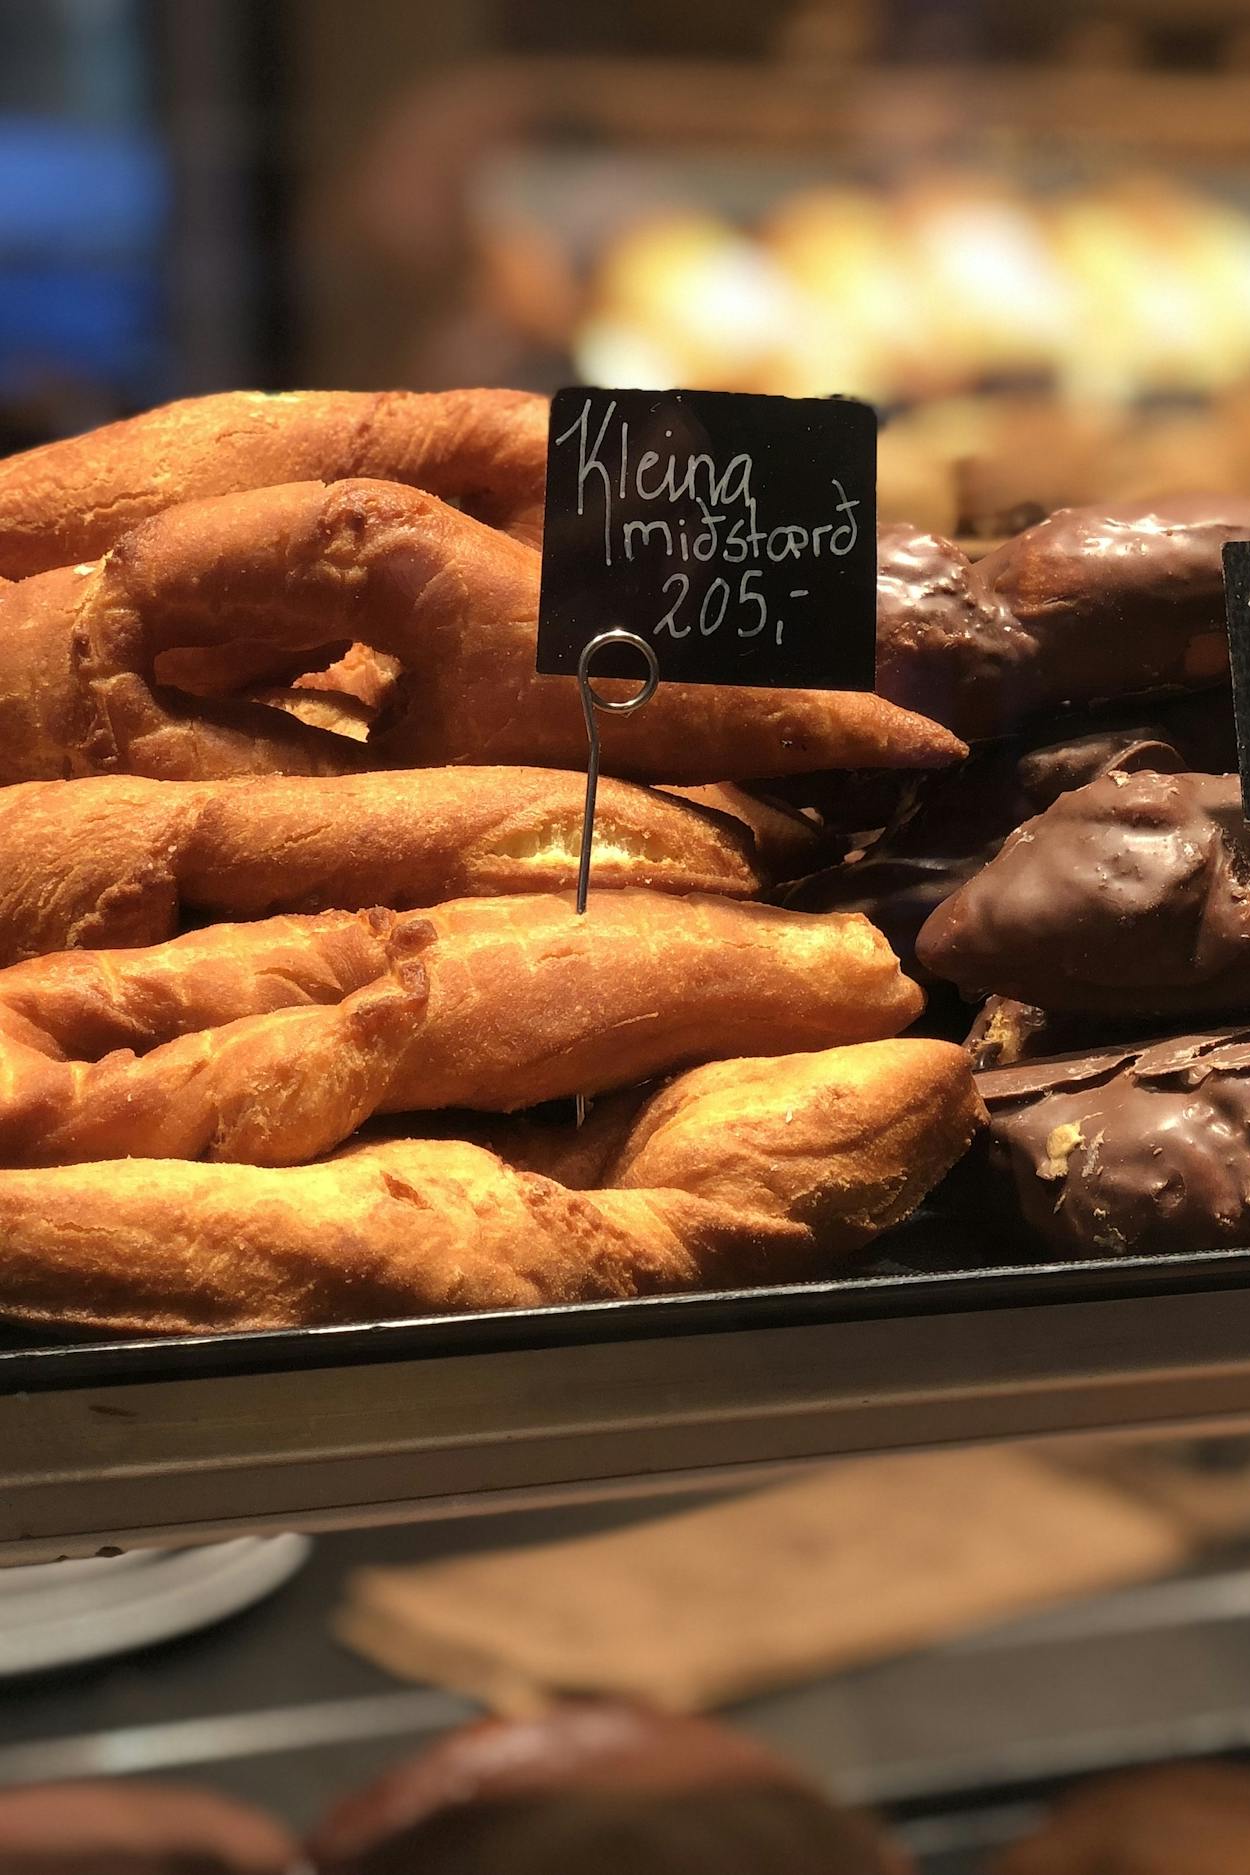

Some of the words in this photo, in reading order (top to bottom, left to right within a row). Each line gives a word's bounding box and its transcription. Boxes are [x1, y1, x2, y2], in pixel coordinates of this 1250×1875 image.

[555, 398, 753, 566] Kleina
[622, 478, 861, 563] miðstærð
[652, 569, 810, 646] 205,-
